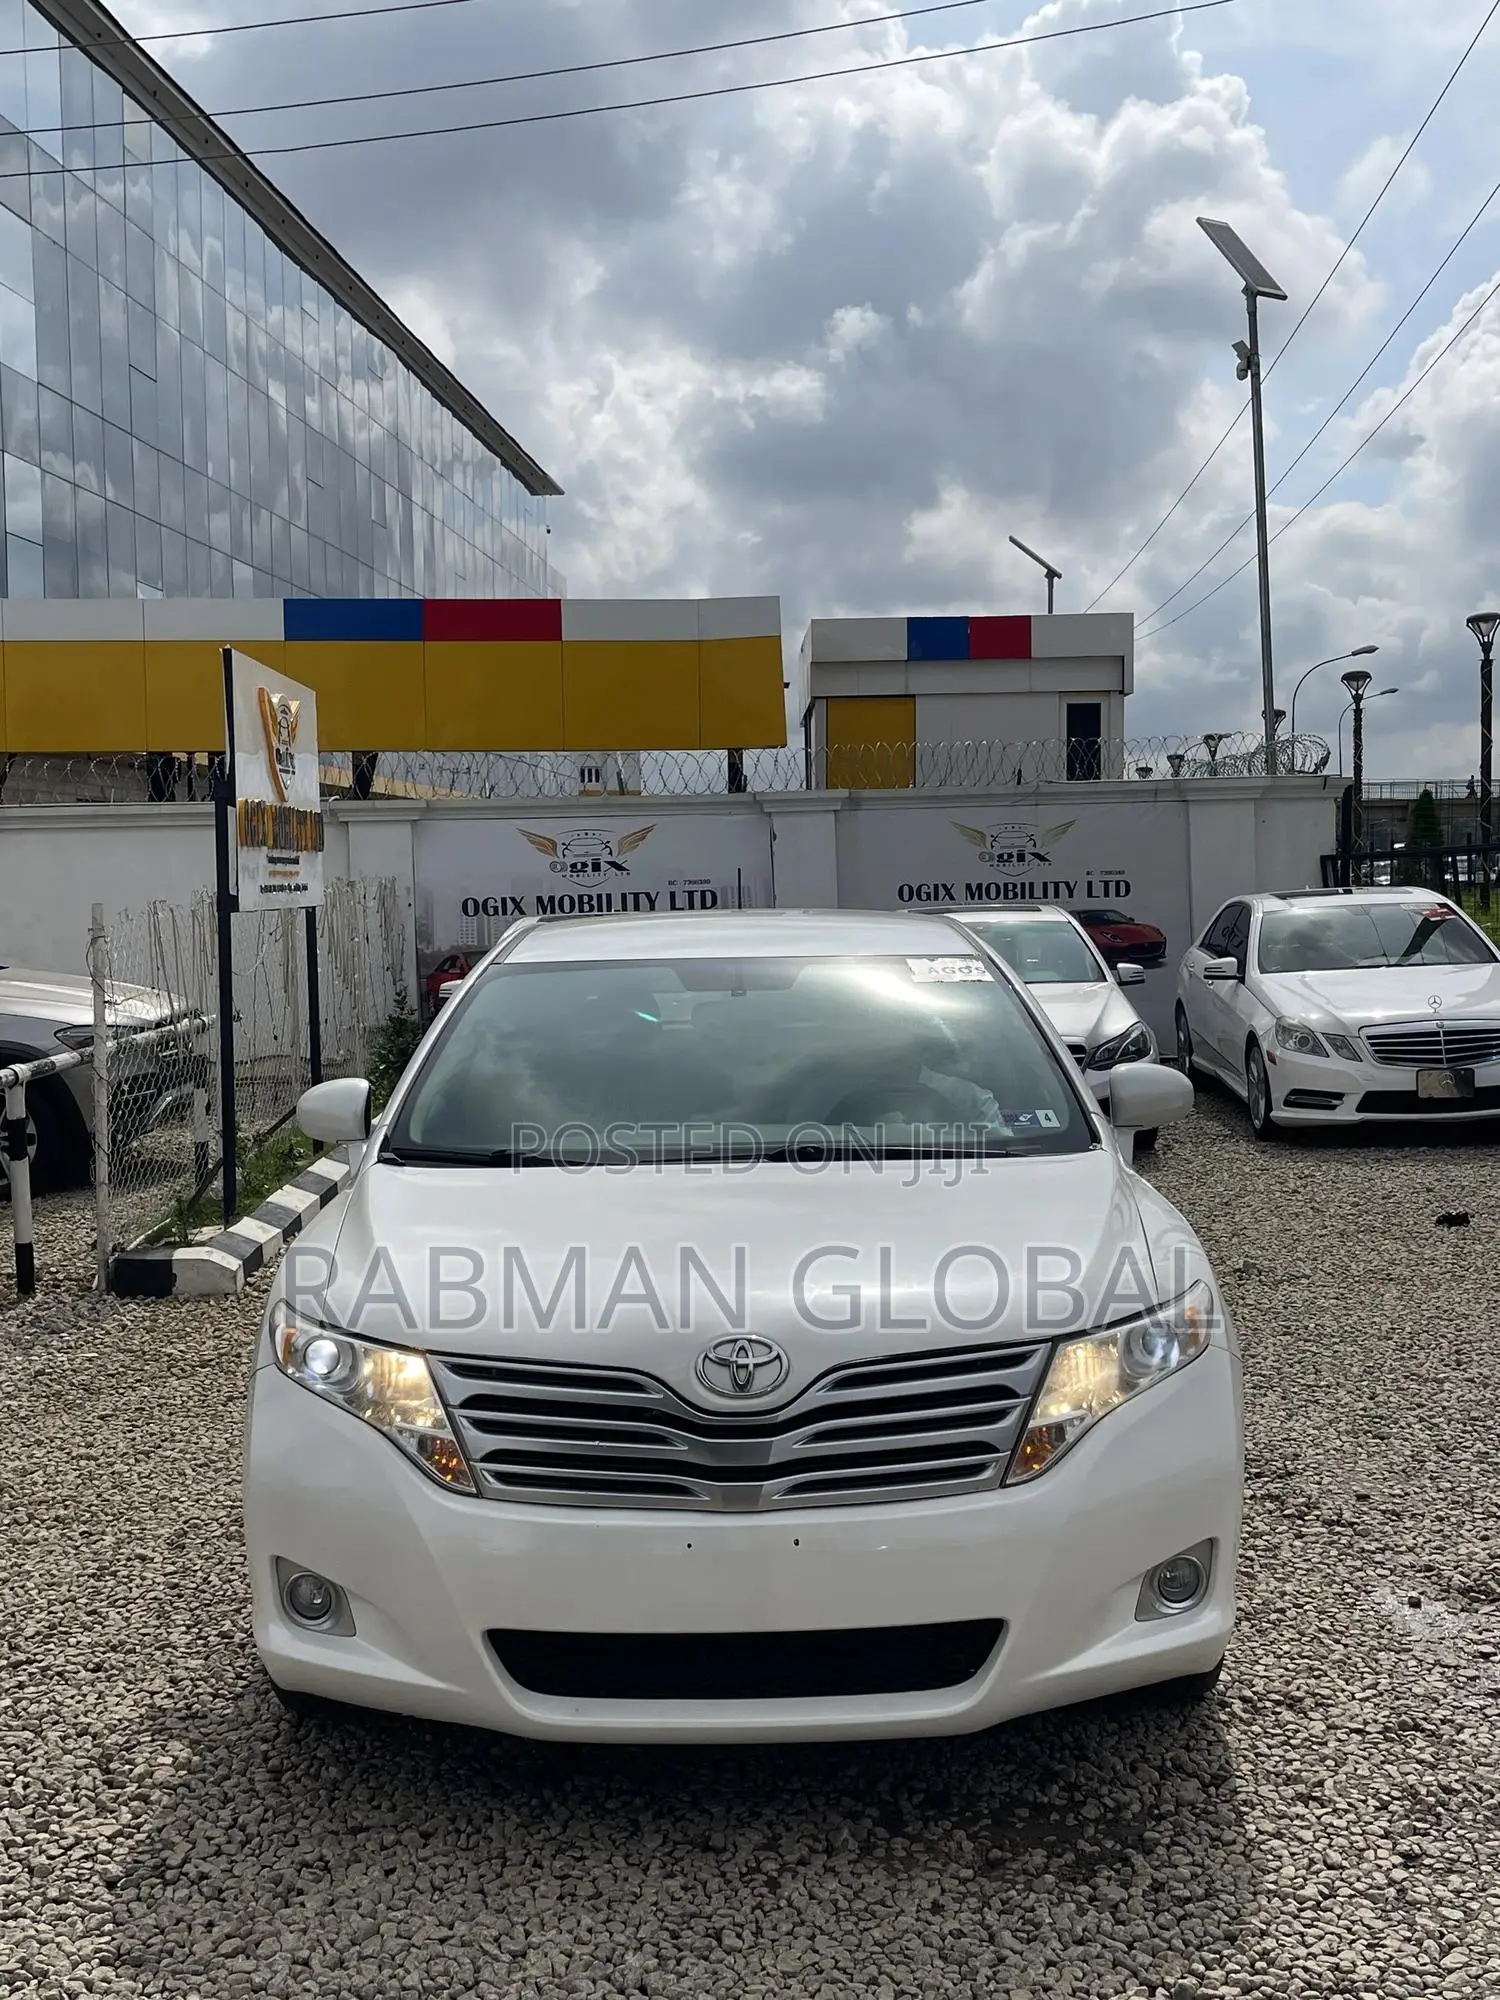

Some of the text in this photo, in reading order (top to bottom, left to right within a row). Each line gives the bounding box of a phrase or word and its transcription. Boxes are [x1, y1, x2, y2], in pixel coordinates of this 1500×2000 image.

[461, 889, 718, 917] OGIX MOBILITY LTD
[897, 879, 1131, 902] OGIX MOBILITY LTD
